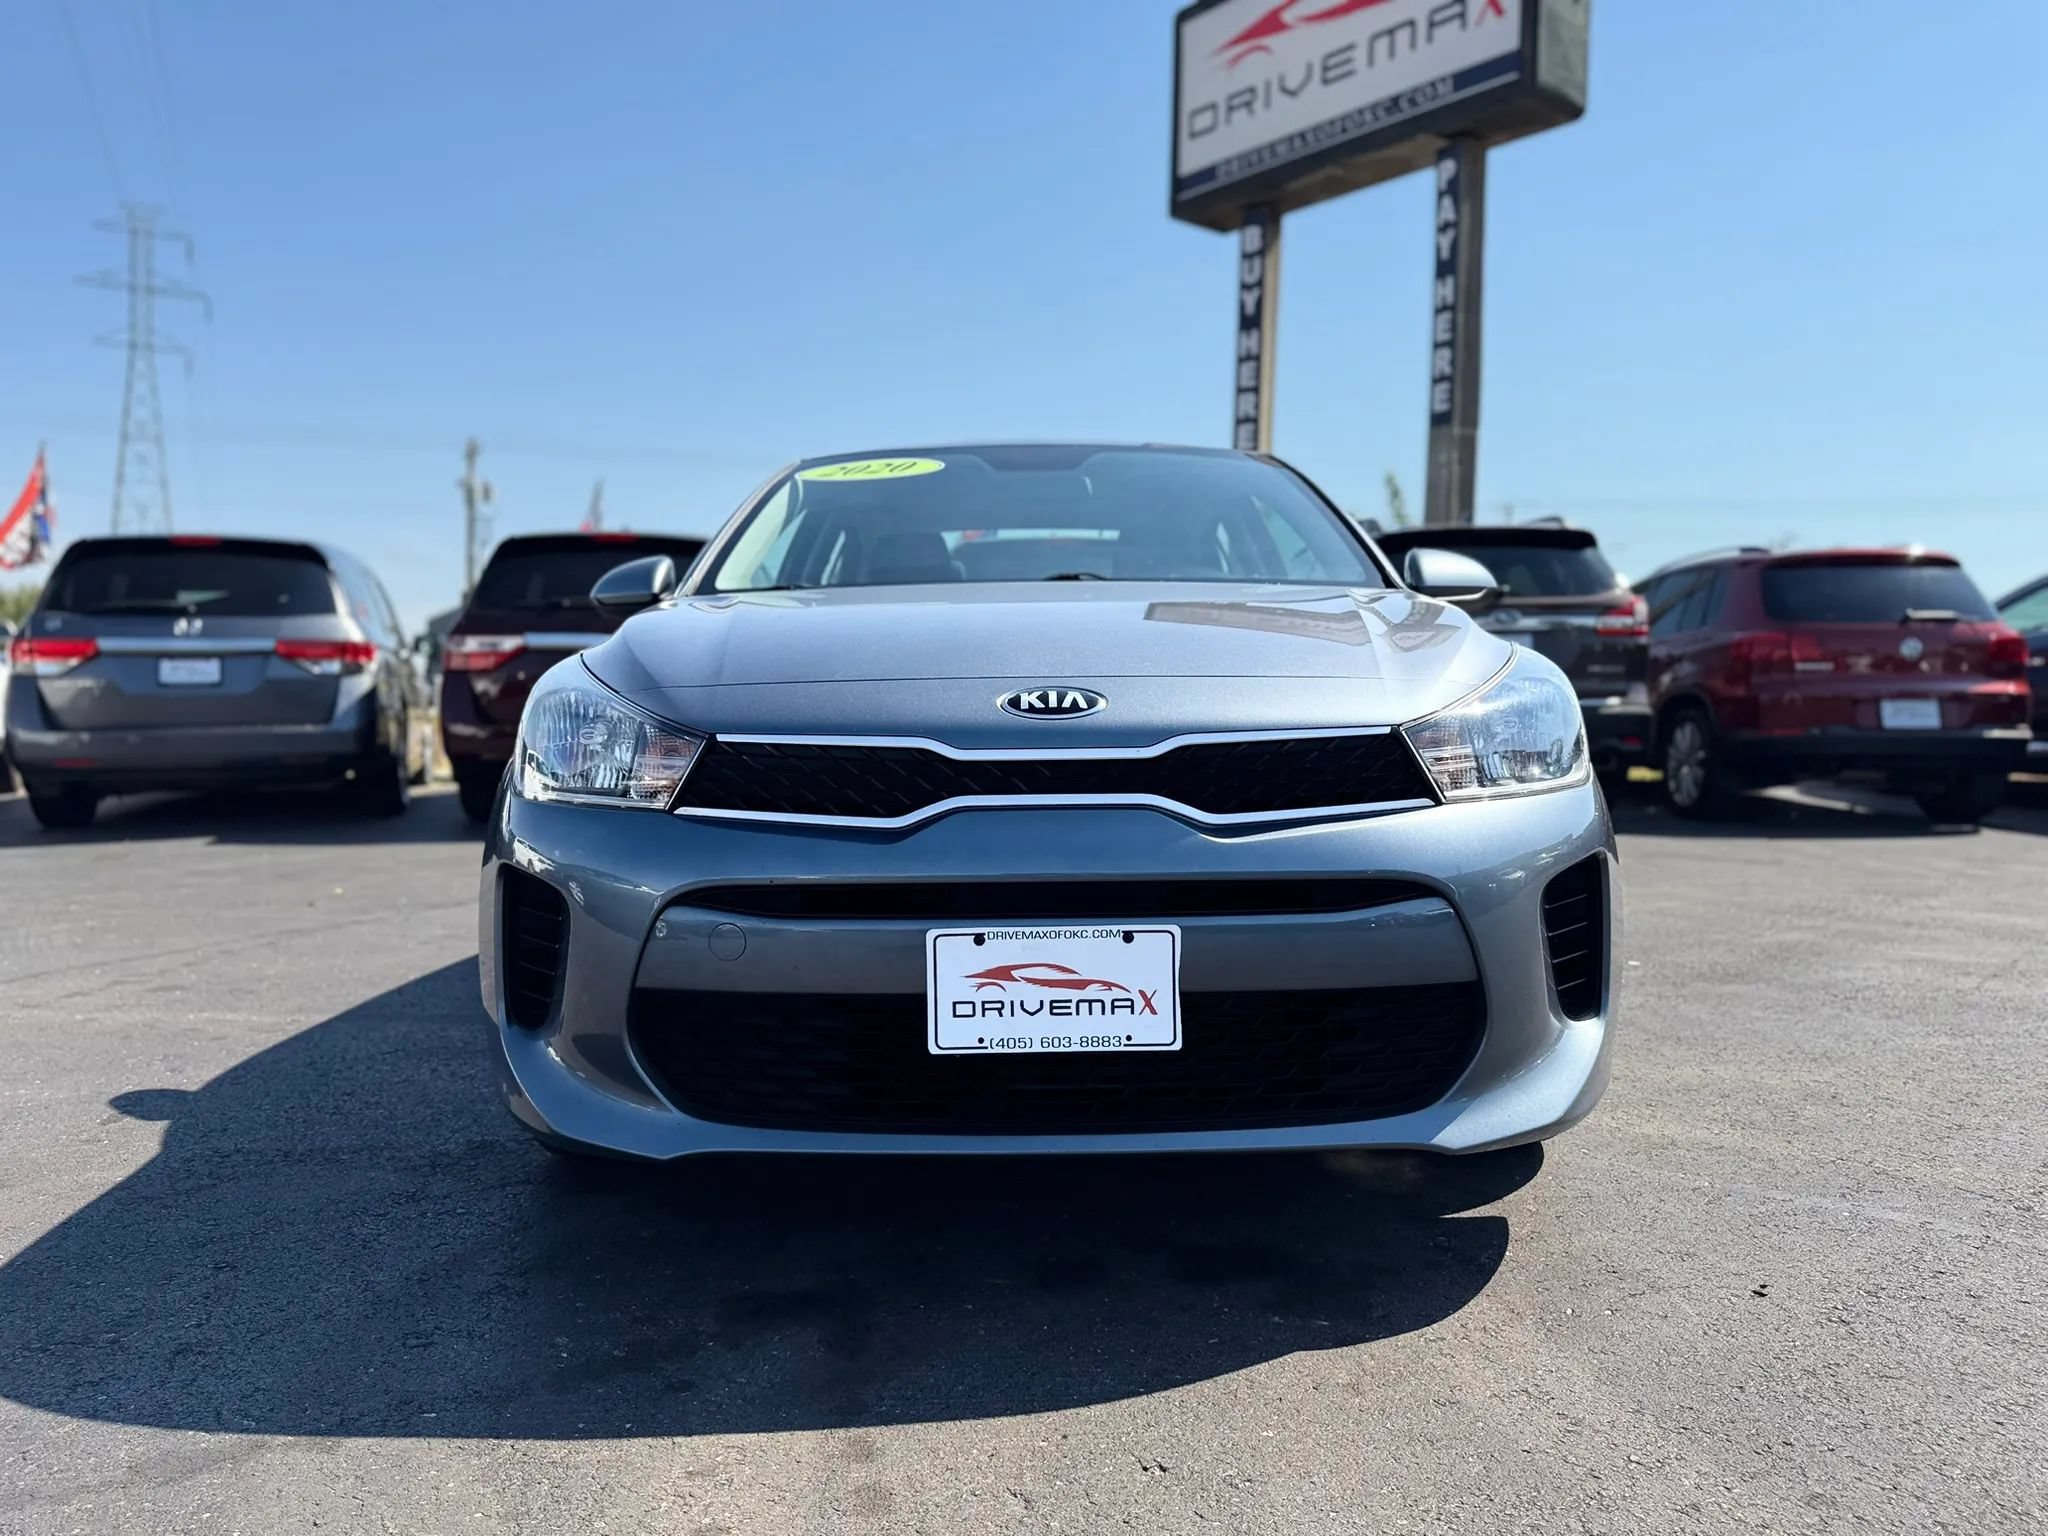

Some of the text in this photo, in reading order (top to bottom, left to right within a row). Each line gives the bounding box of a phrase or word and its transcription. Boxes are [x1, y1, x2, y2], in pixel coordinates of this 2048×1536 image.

[1432, 157, 1458, 414] PAY HERE
[1236, 224, 1264, 451] BUY HERE
[815, 461, 918, 478] 2020
[1019, 690, 1089, 709] KIA
[986, 928, 1122, 941] DRIVEMAXOFOKC.COM
[952, 989, 1158, 1018] DRIVEMAX
[989, 1035, 1123, 1050] (405) 603-8883
